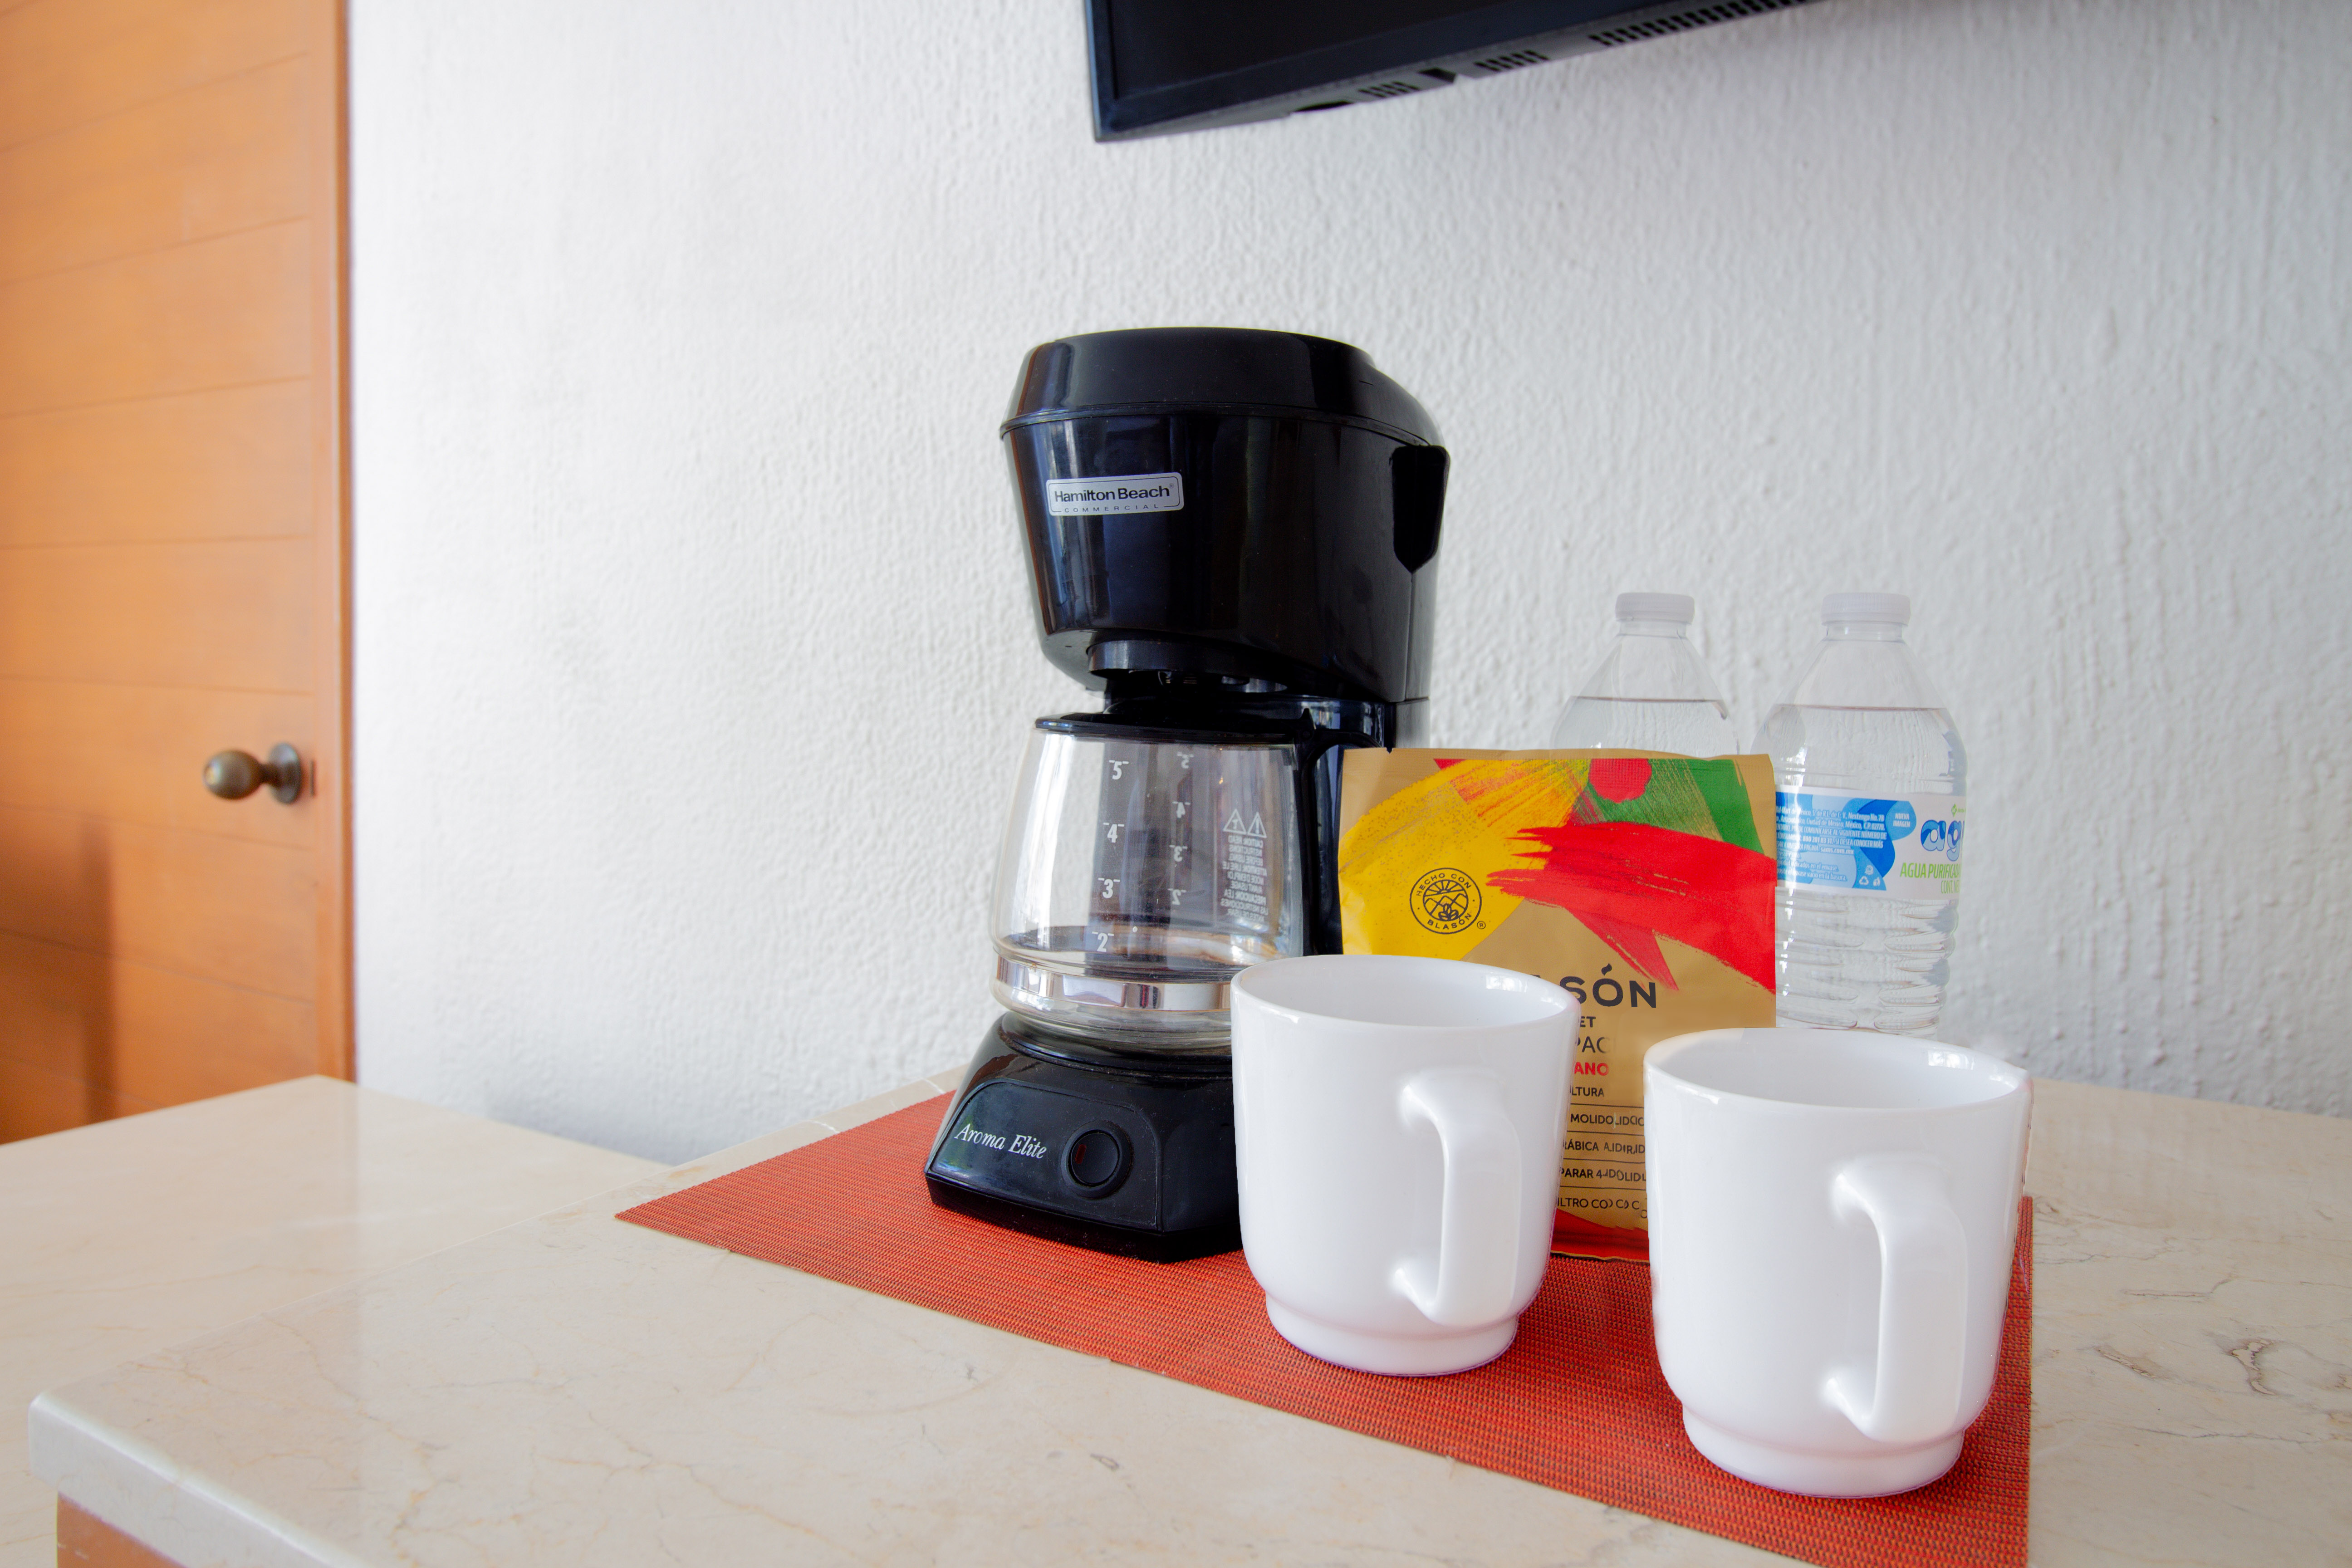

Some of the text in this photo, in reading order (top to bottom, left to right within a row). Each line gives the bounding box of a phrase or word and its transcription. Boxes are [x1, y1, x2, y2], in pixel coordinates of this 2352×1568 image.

[1054, 485, 1170, 502] Hamilton Beach
[1064, 505, 1158, 513] COMMERCIAL
[1112, 762, 1122, 779] 5
[1107, 824, 1117, 843] 4
[1921, 819, 1965, 862] ag
[1900, 862, 1926, 878] AGUA
[1102, 879, 1113, 898] 3
[1416, 873, 1471, 896] HECHO CON
[1098, 933, 1108, 952] 2
[1530, 963, 1657, 1008] SÓN
[954, 1123, 1047, 1159] Aroma Elite
